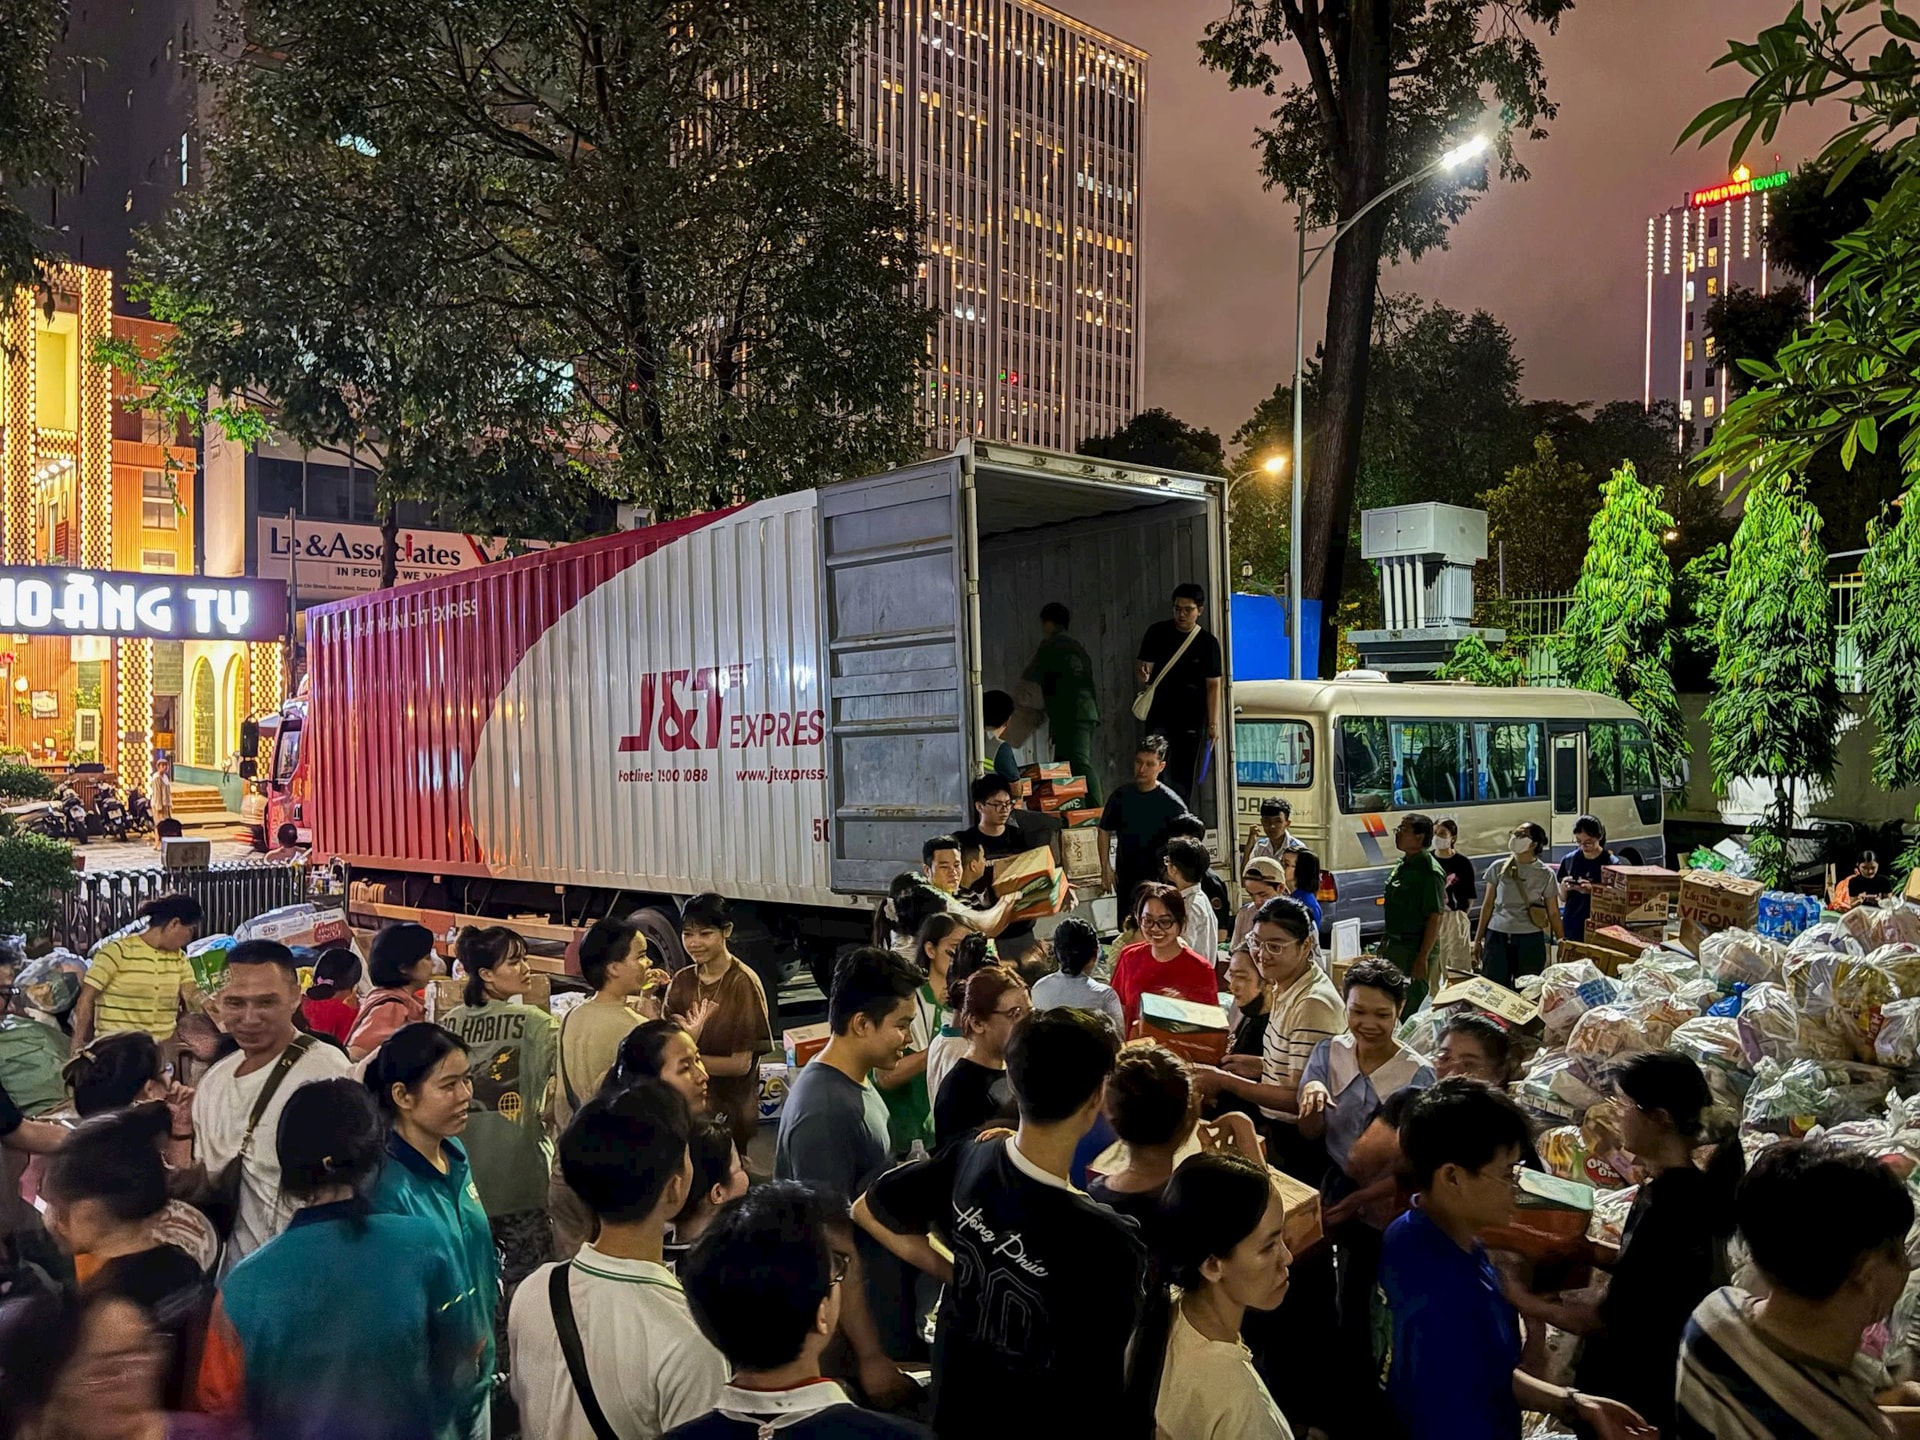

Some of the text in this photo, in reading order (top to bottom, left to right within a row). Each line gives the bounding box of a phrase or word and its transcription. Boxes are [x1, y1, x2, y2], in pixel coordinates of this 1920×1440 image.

[337, 567, 349, 576] IN
[403, 571, 420, 580] WE
[618, 663, 825, 752] J&T EXPRES
[736, 765, 829, 785] www.jtexpress.
[1681, 904, 1737, 927] VIFON
[461, 1013, 526, 1043] HABITS
